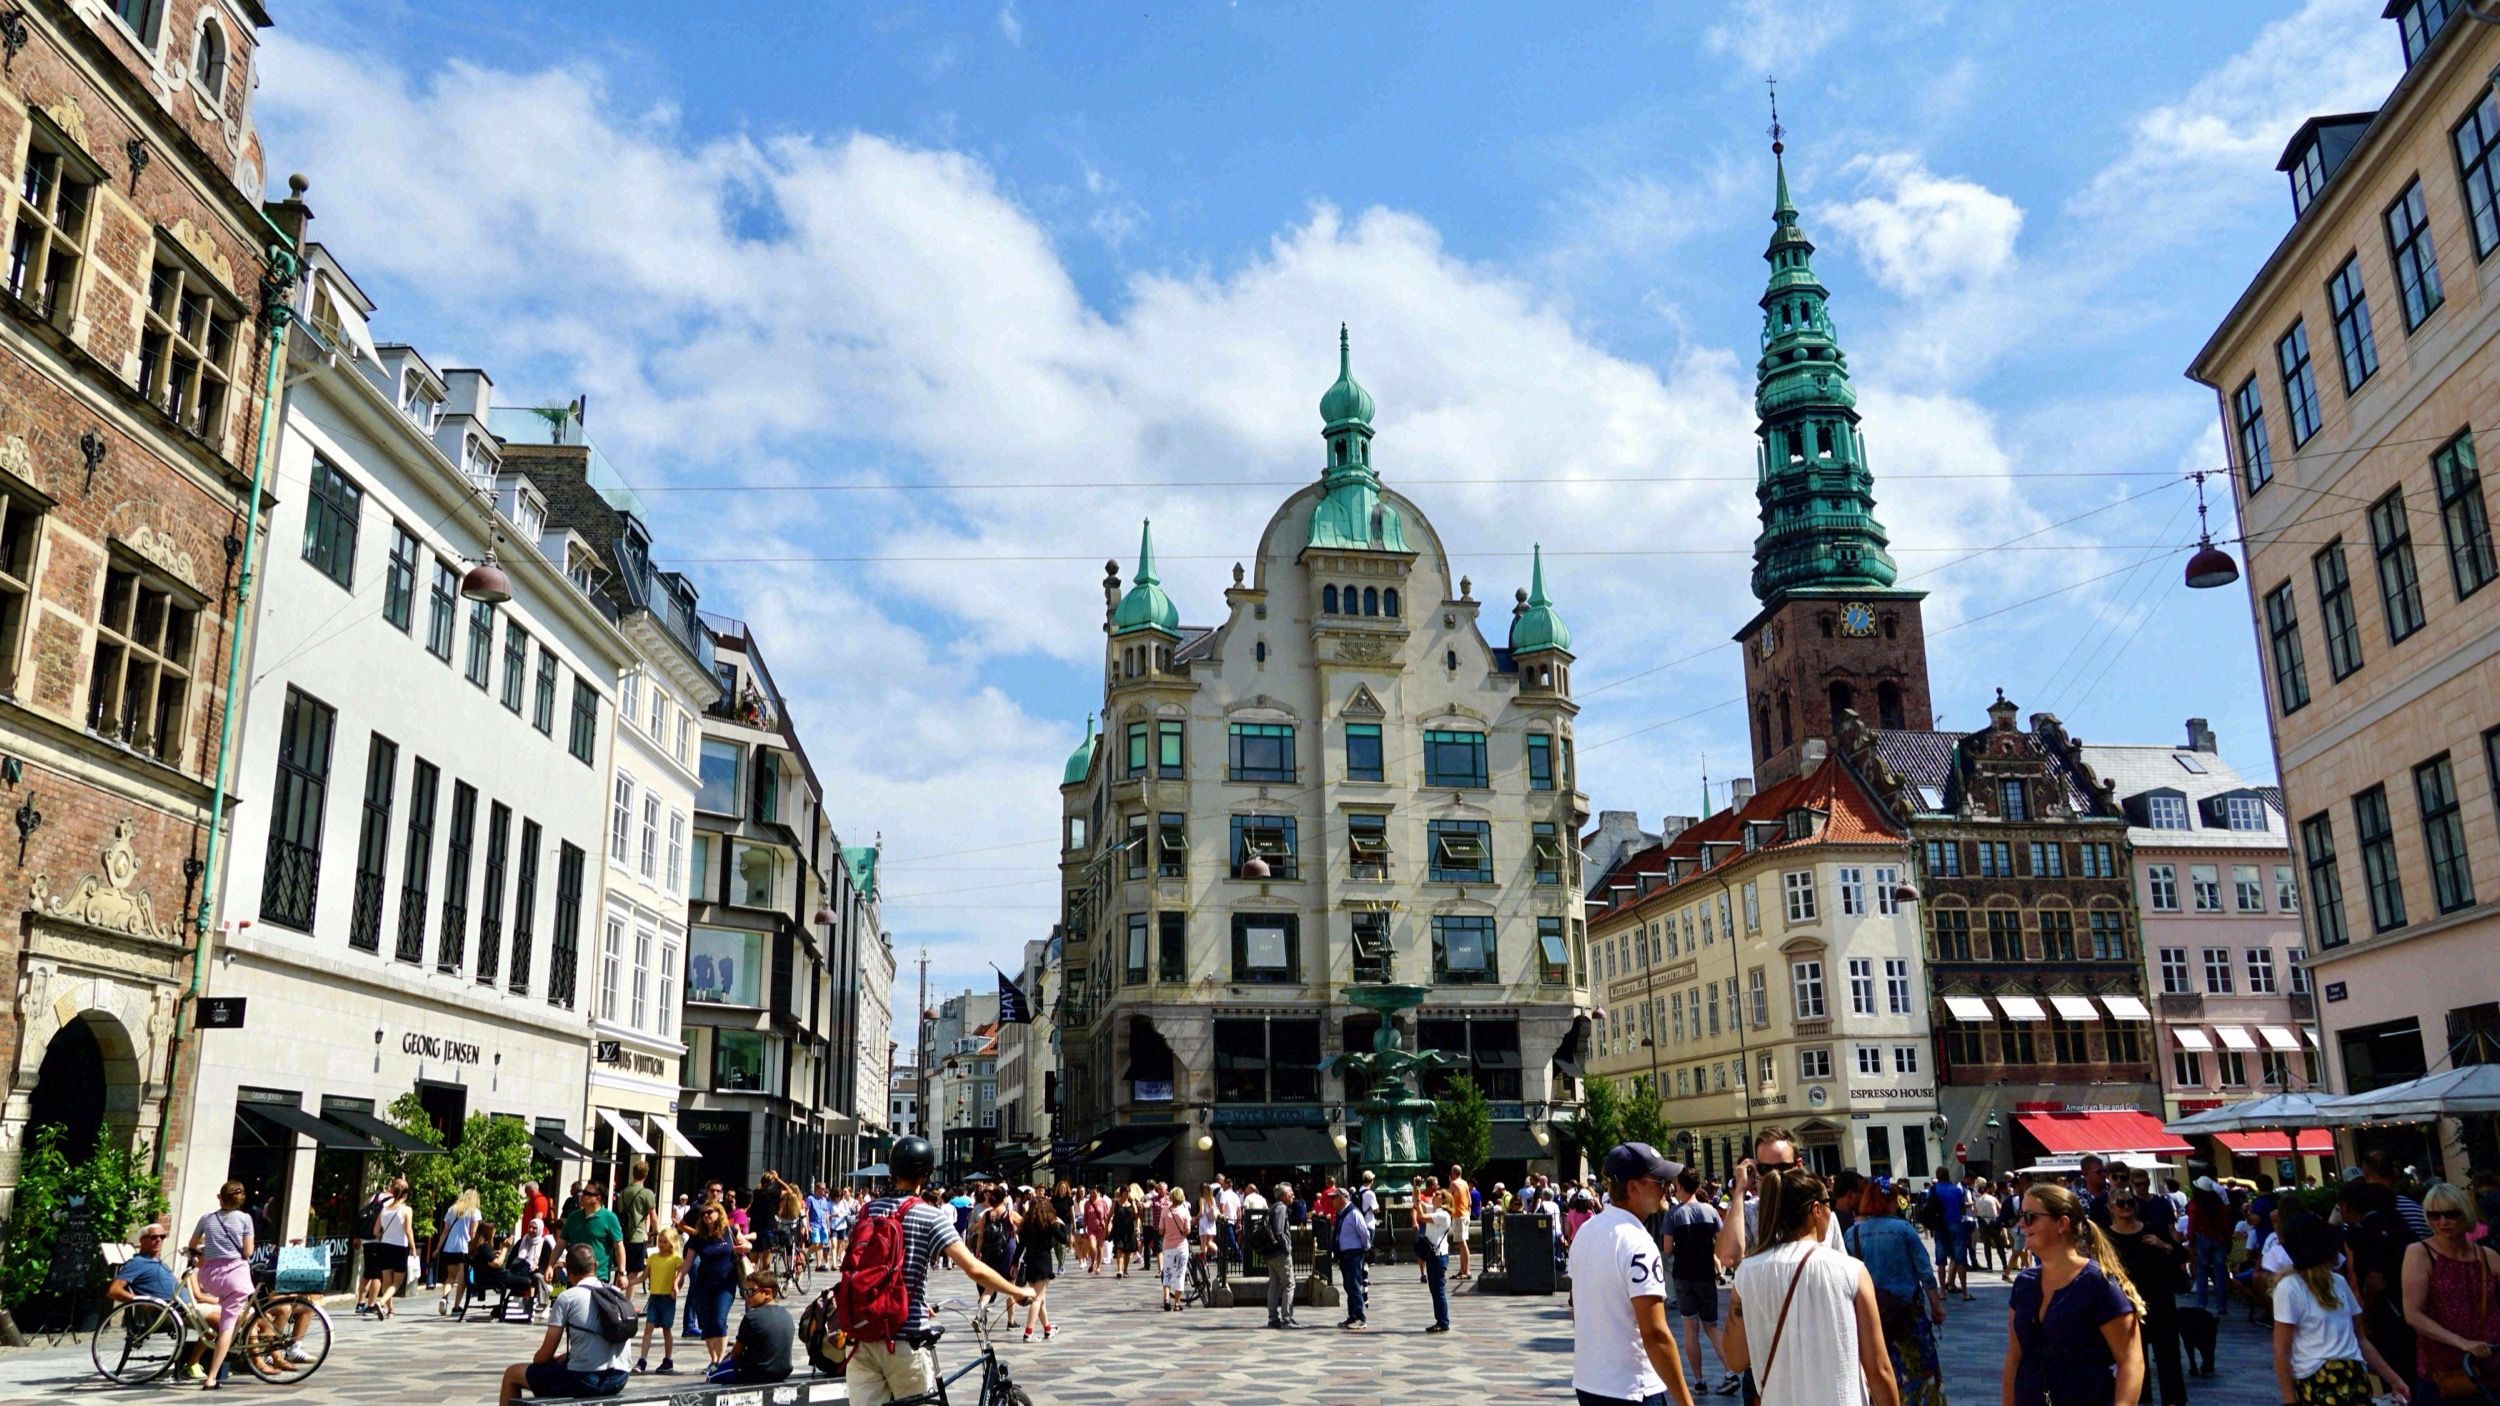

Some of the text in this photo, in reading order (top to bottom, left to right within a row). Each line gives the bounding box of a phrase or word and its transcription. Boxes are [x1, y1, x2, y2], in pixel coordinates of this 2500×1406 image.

[1001, 987, 1016, 1021] HAY
[402, 1032, 480, 1065] GEORG JENSEN
[633, 1053, 665, 1078] VUITTON
[1750, 1095, 1788, 1107] ESPRESSO HOUSE
[1850, 1088, 1935, 1099] ESPRESSO HOUSE
[699, 1123, 730, 1131] PRADA
[1631, 1253, 1664, 1283] 56
